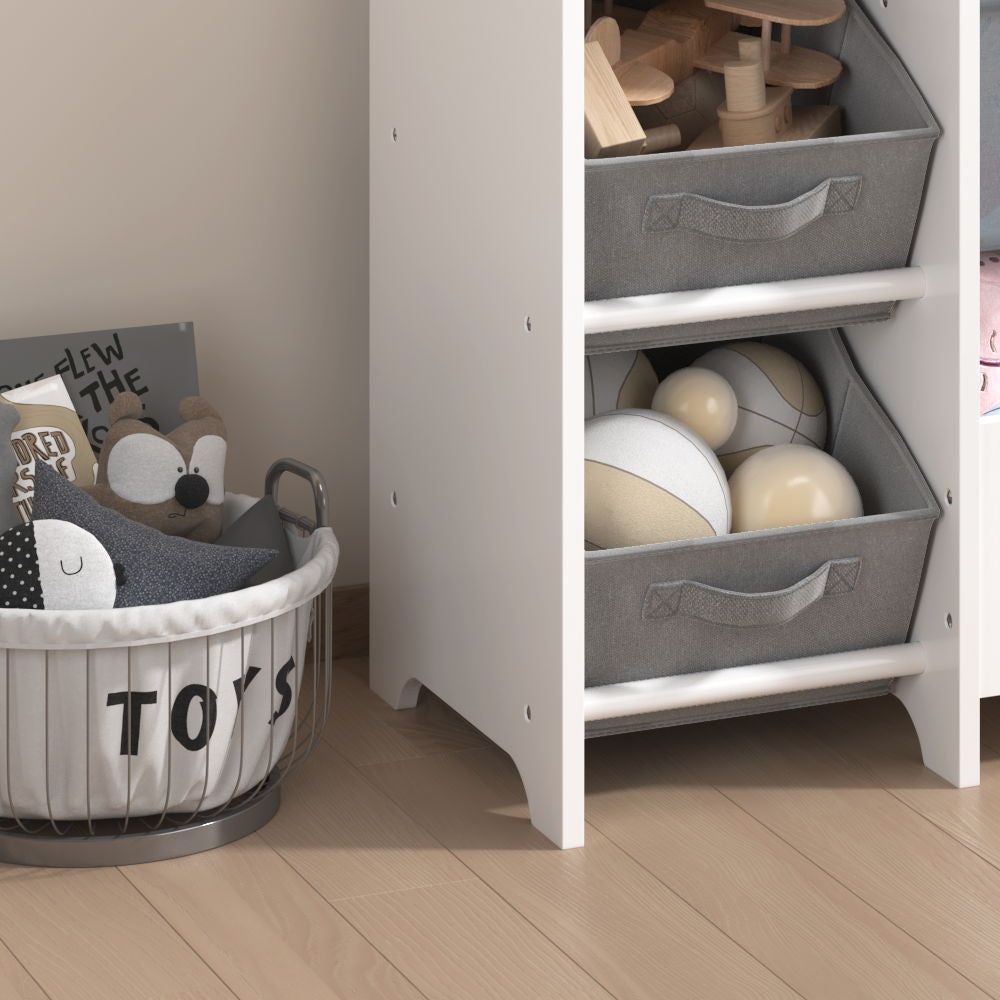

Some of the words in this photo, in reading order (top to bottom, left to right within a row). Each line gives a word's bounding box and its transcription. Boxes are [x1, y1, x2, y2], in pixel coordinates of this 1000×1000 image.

[54, 332, 124, 379] FLEW
[79, 367, 149, 413] THE
[12, 431, 70, 467] DRED
